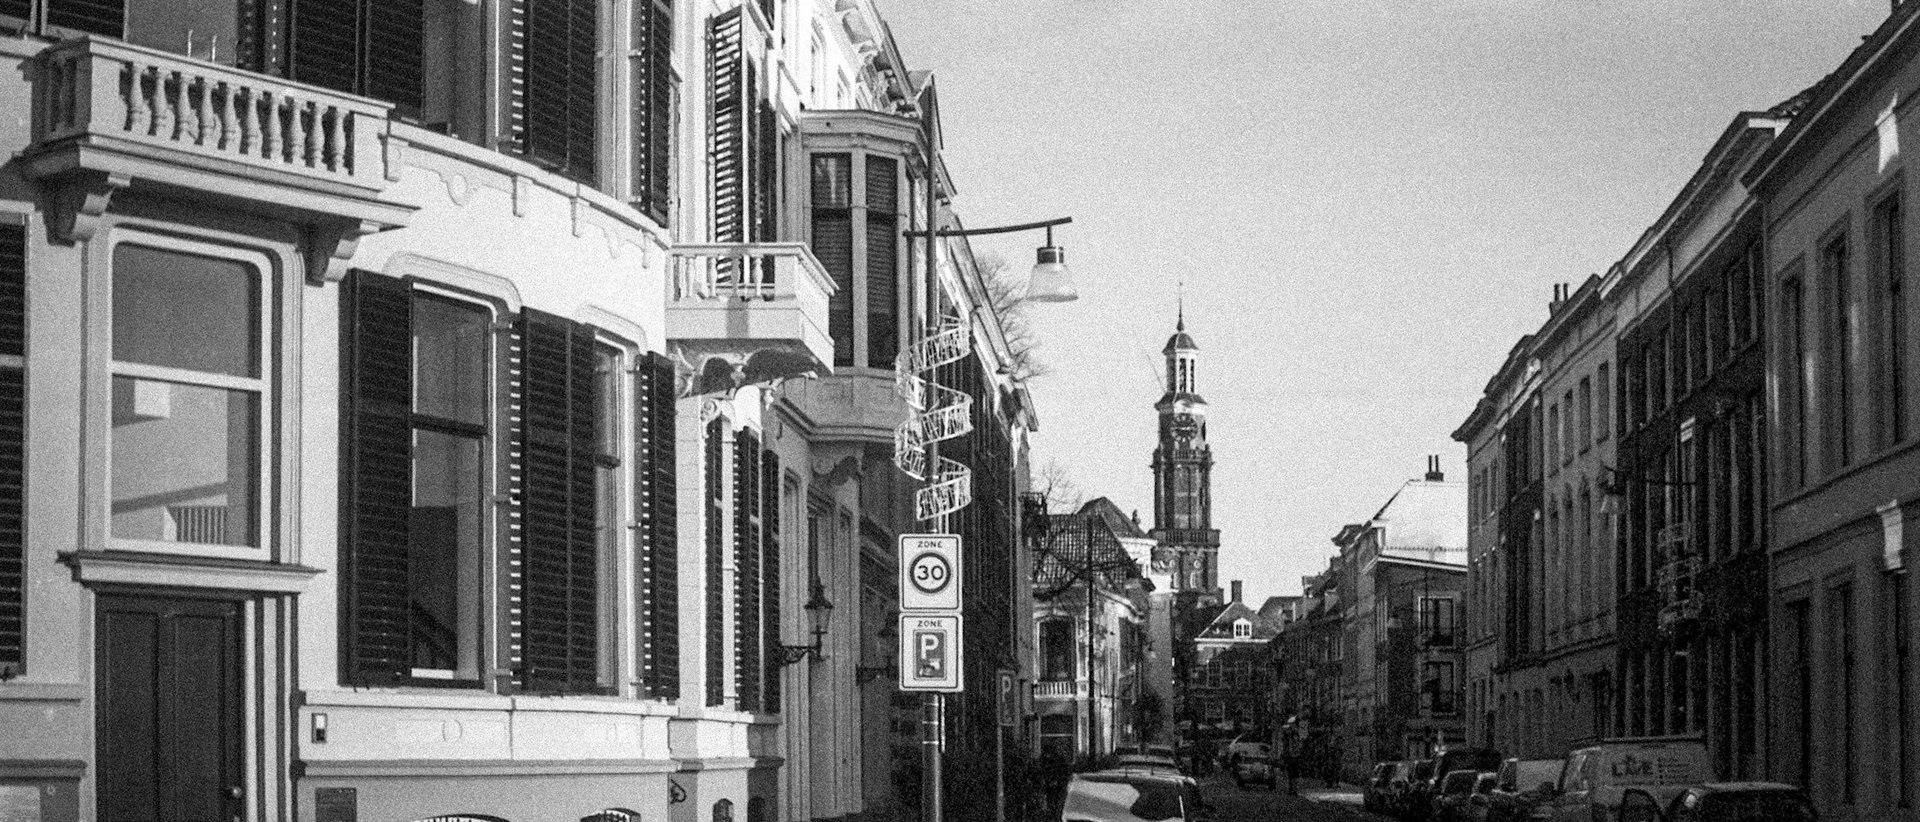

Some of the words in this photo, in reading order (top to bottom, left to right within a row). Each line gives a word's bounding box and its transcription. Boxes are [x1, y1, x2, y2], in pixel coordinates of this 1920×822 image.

[917, 565, 944, 581] 30
[917, 620, 943, 628] ZONE
[921, 634, 939, 660] P
